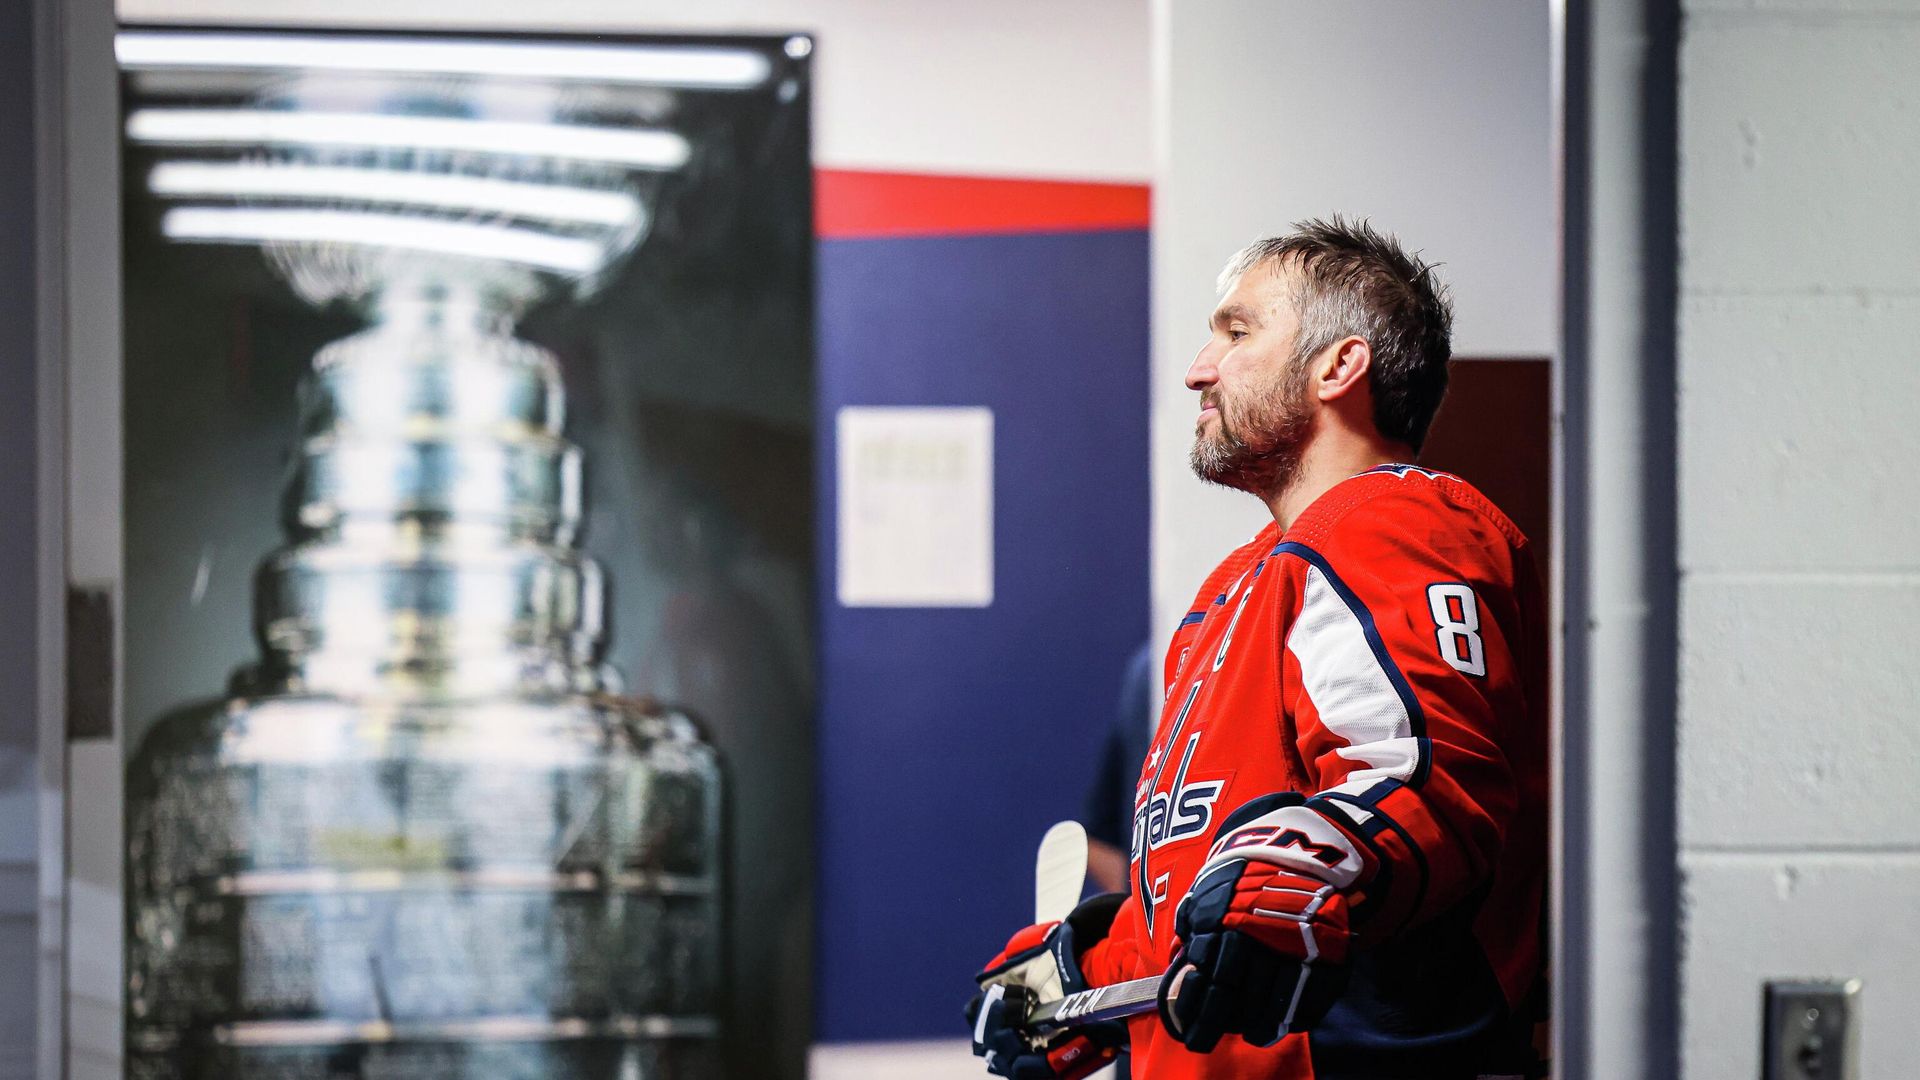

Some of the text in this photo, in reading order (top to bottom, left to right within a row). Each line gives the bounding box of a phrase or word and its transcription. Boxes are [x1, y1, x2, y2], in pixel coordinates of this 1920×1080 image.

[1426, 583, 1487, 678] 8
[1207, 826, 1349, 868] CM
[1055, 986, 1108, 1021] CCM
